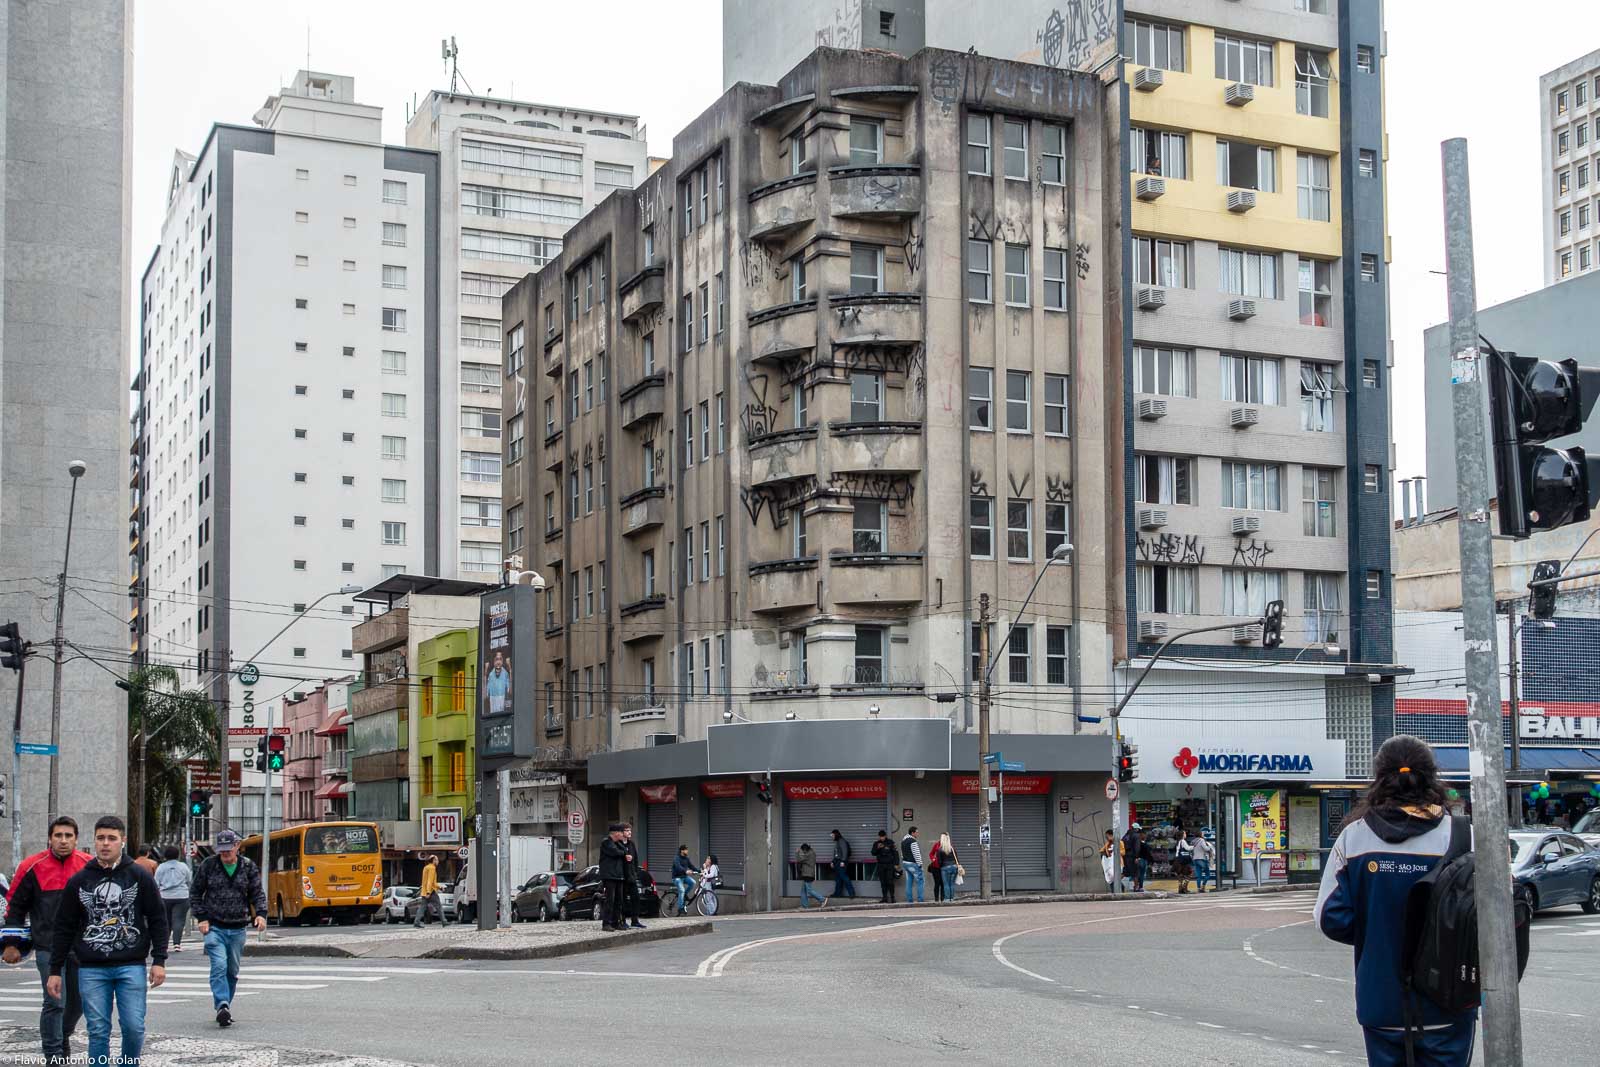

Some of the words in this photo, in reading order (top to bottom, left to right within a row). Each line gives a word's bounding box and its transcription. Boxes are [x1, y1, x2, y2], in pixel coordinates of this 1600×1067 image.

[1519, 715, 1600, 738] BAHI
[1199, 755, 1313, 771] MORIFARMA
[962, 779, 996, 787] espo
[429, 815, 456, 833] FOTO
[573, 814, 580, 825] E
[345, 830, 369, 840] NOTA
[459, 848, 469, 856] 40
[351, 864, 375, 872] BC017
